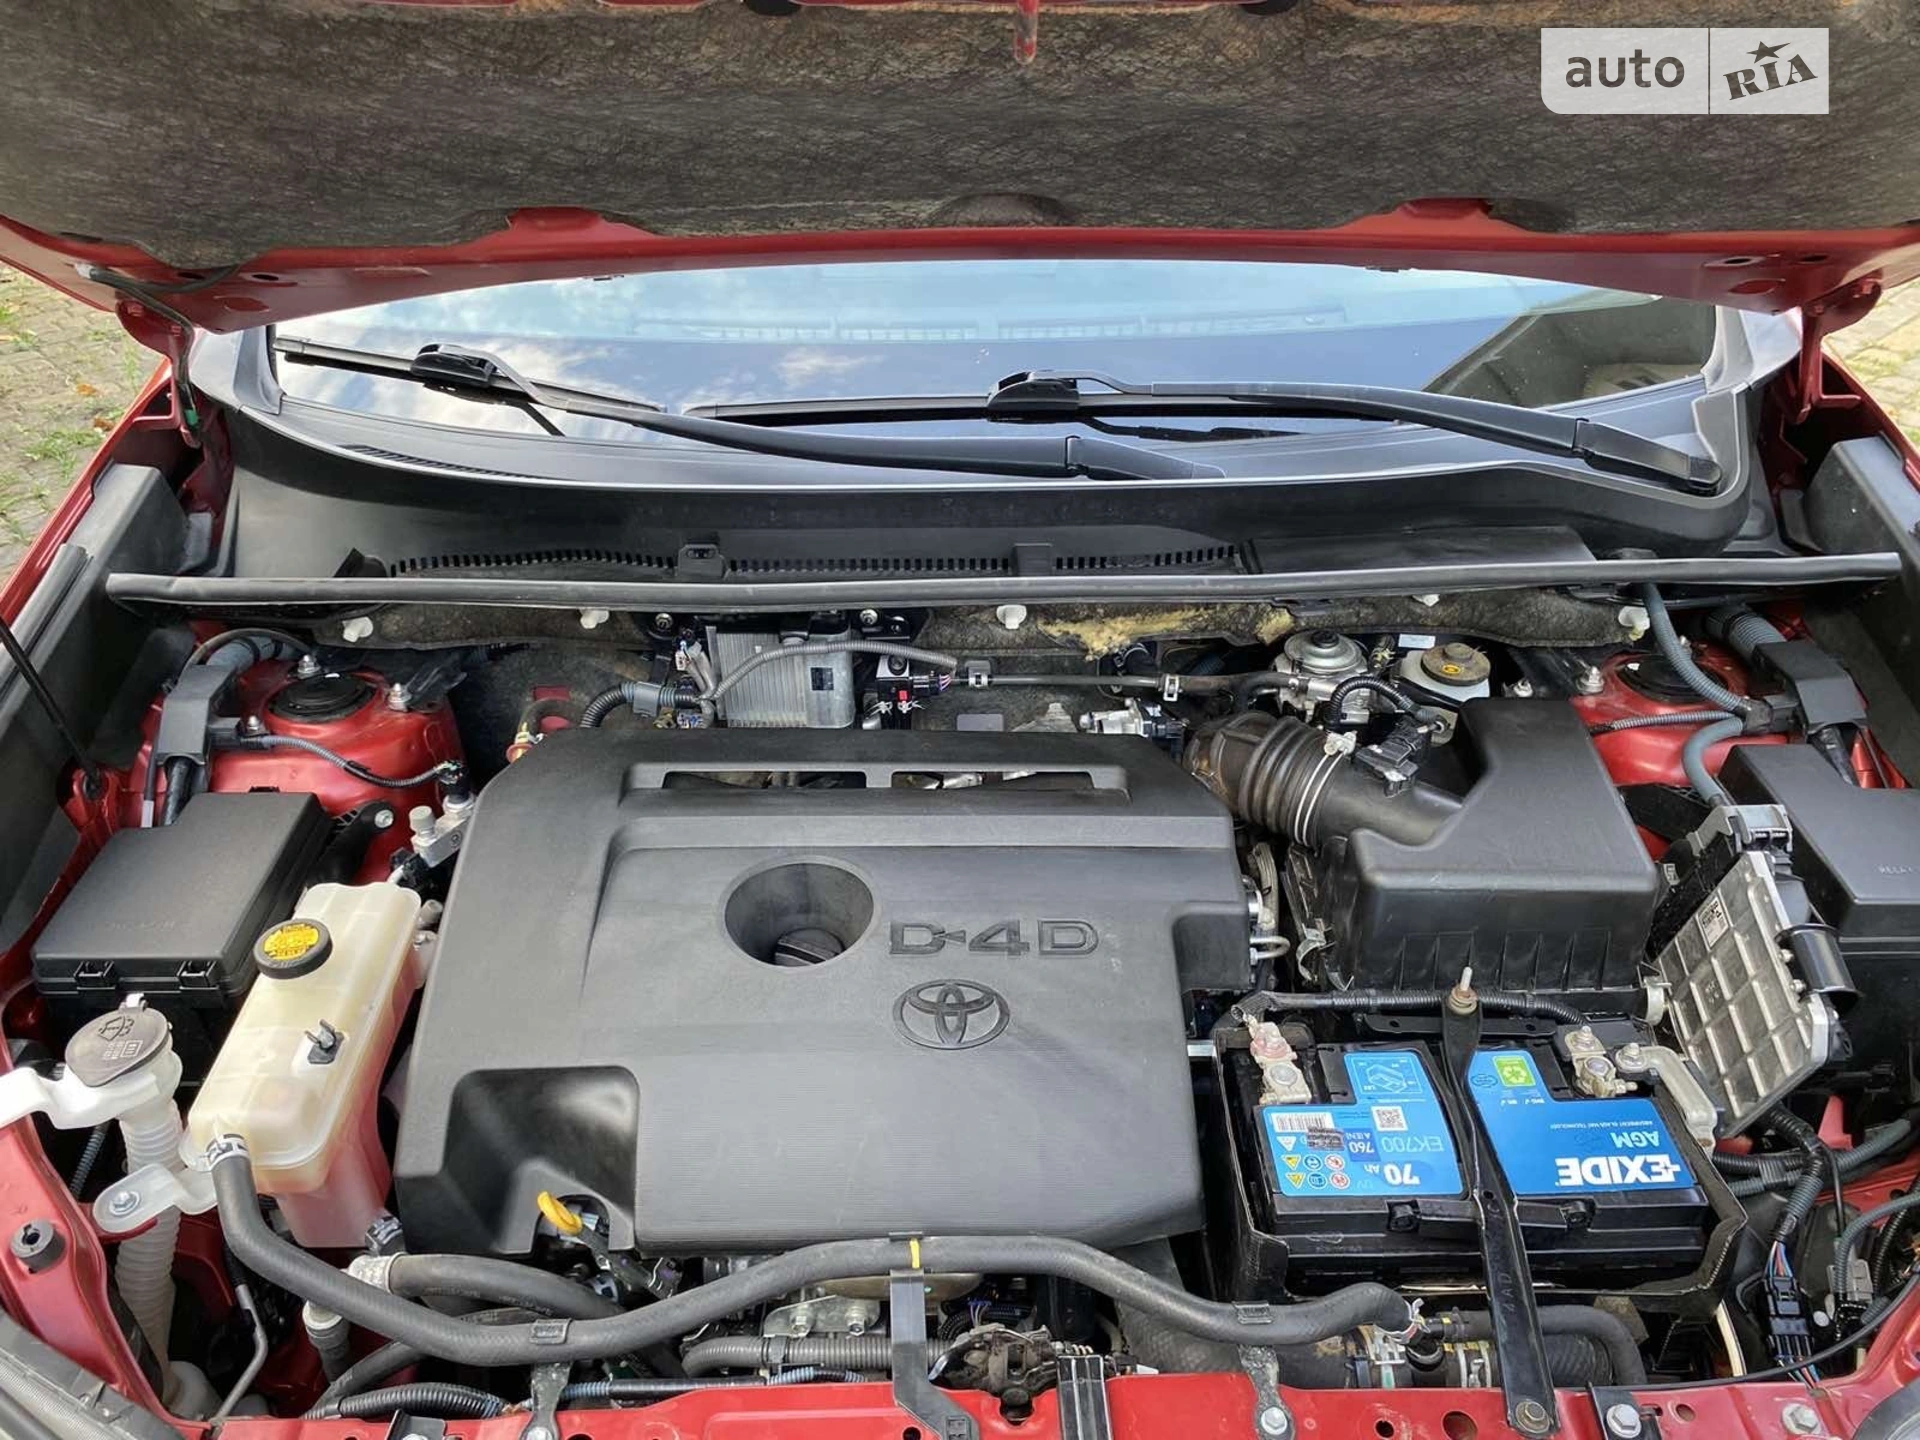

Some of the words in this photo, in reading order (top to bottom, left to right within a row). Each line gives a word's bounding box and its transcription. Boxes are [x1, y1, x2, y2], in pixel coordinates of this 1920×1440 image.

[889, 919, 1099, 956] D-4D
[1350, 1141, 1374, 1153] 760
[1382, 1135, 1444, 1153] EK700
[1609, 1130, 1660, 1148] AGM
[1384, 1163, 1420, 1185] 70
[1555, 1154, 1681, 1187] EXIDE
